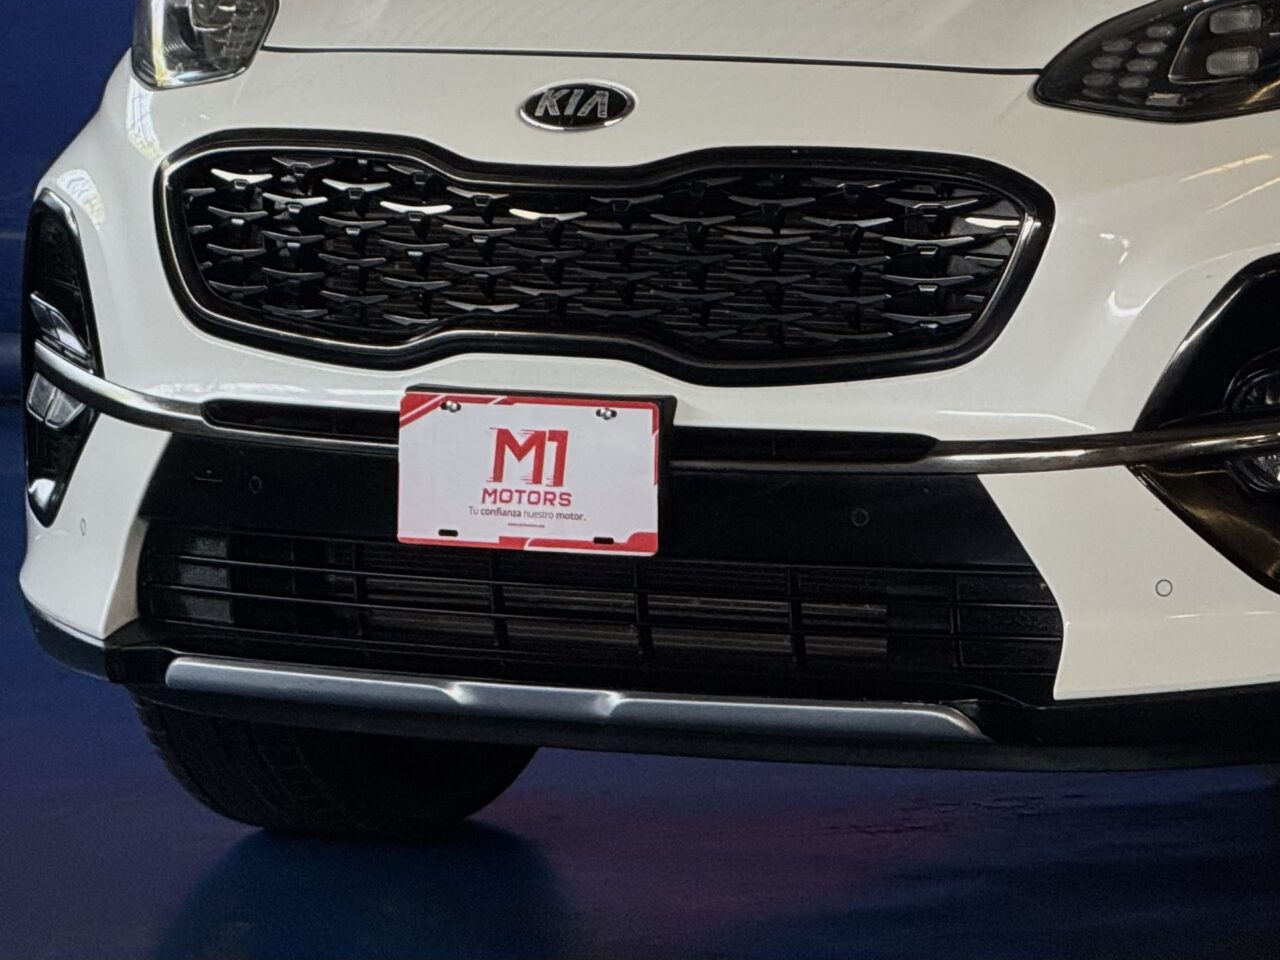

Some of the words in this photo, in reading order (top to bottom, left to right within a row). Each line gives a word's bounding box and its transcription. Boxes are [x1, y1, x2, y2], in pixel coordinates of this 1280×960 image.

[534, 88, 609, 118] KIA
[487, 427, 569, 487] M1
[481, 488, 573, 507] MOTORS
[469, 505, 479, 516] Tu
[480, 506, 522, 518] confianza
[523, 510, 554, 520] nuestro
[556, 512, 587, 521] motor.
